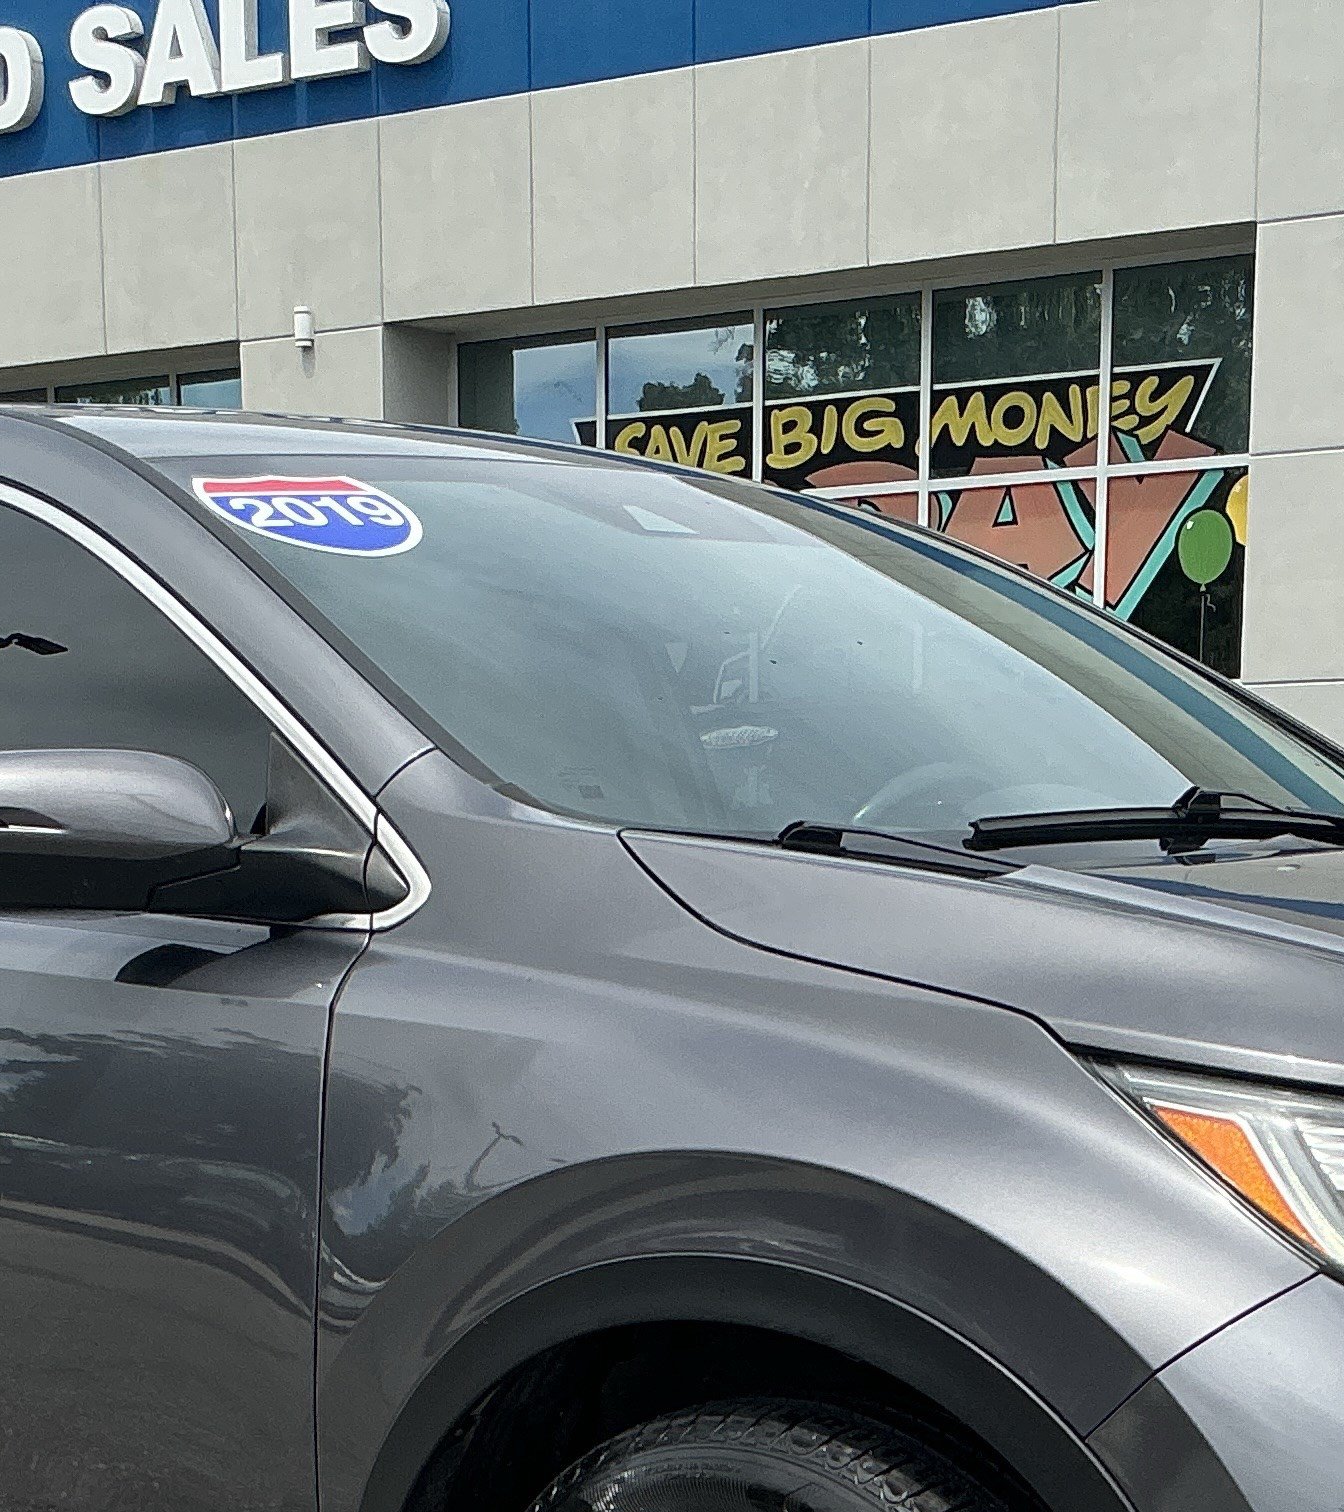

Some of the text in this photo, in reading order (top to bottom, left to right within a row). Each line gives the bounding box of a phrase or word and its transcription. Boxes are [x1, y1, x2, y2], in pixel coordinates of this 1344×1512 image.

[68, 0, 450, 117] SALES
[613, 375, 1195, 474] SAVE BIG MONEY
[229, 496, 405, 528] 2019
